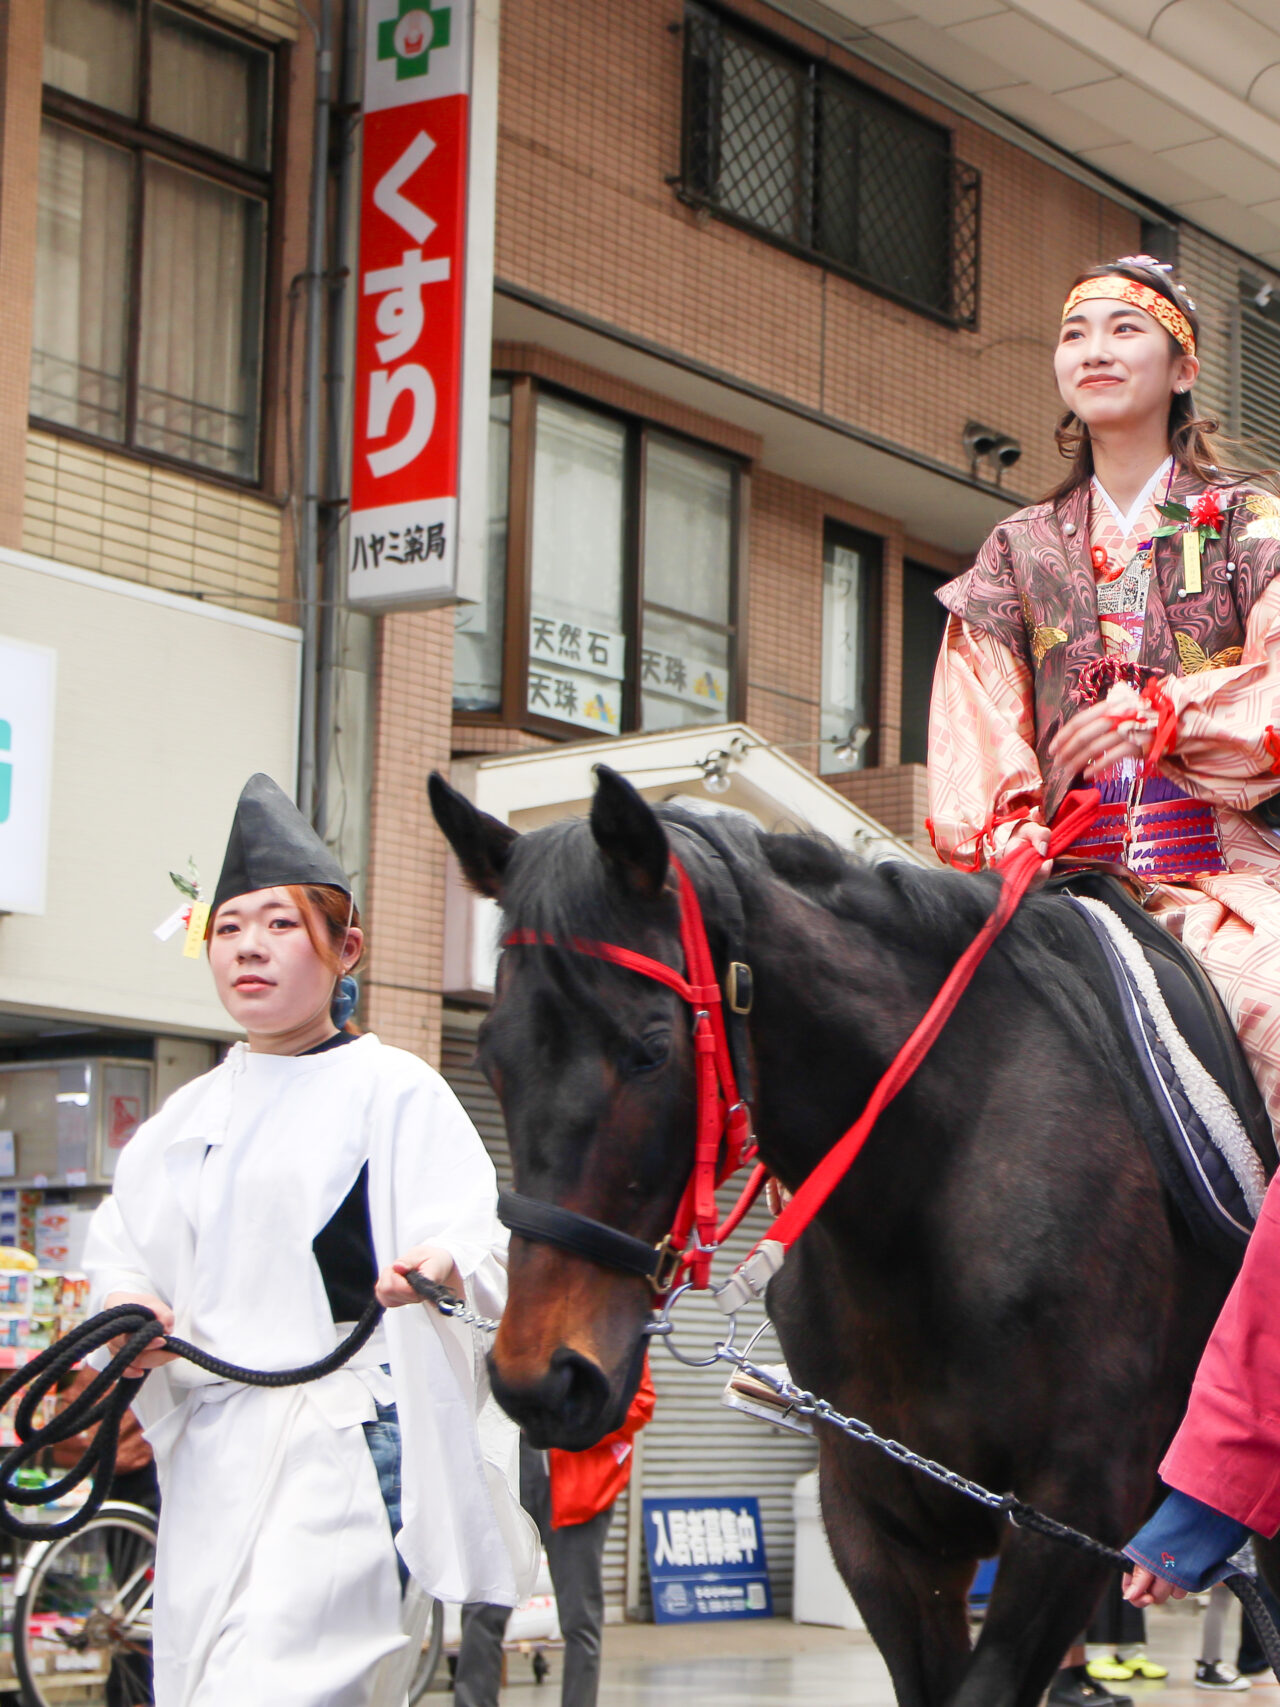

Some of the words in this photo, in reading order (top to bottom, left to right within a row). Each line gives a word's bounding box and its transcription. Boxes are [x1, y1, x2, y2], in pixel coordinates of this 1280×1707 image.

[363, 130, 450, 478] くすり
[352, 522, 446, 572] ハヤミ薬局
[532, 617, 610, 665] 天然石
[530, 672, 577, 717] 天珠
[642, 649, 687, 692] 天珠
